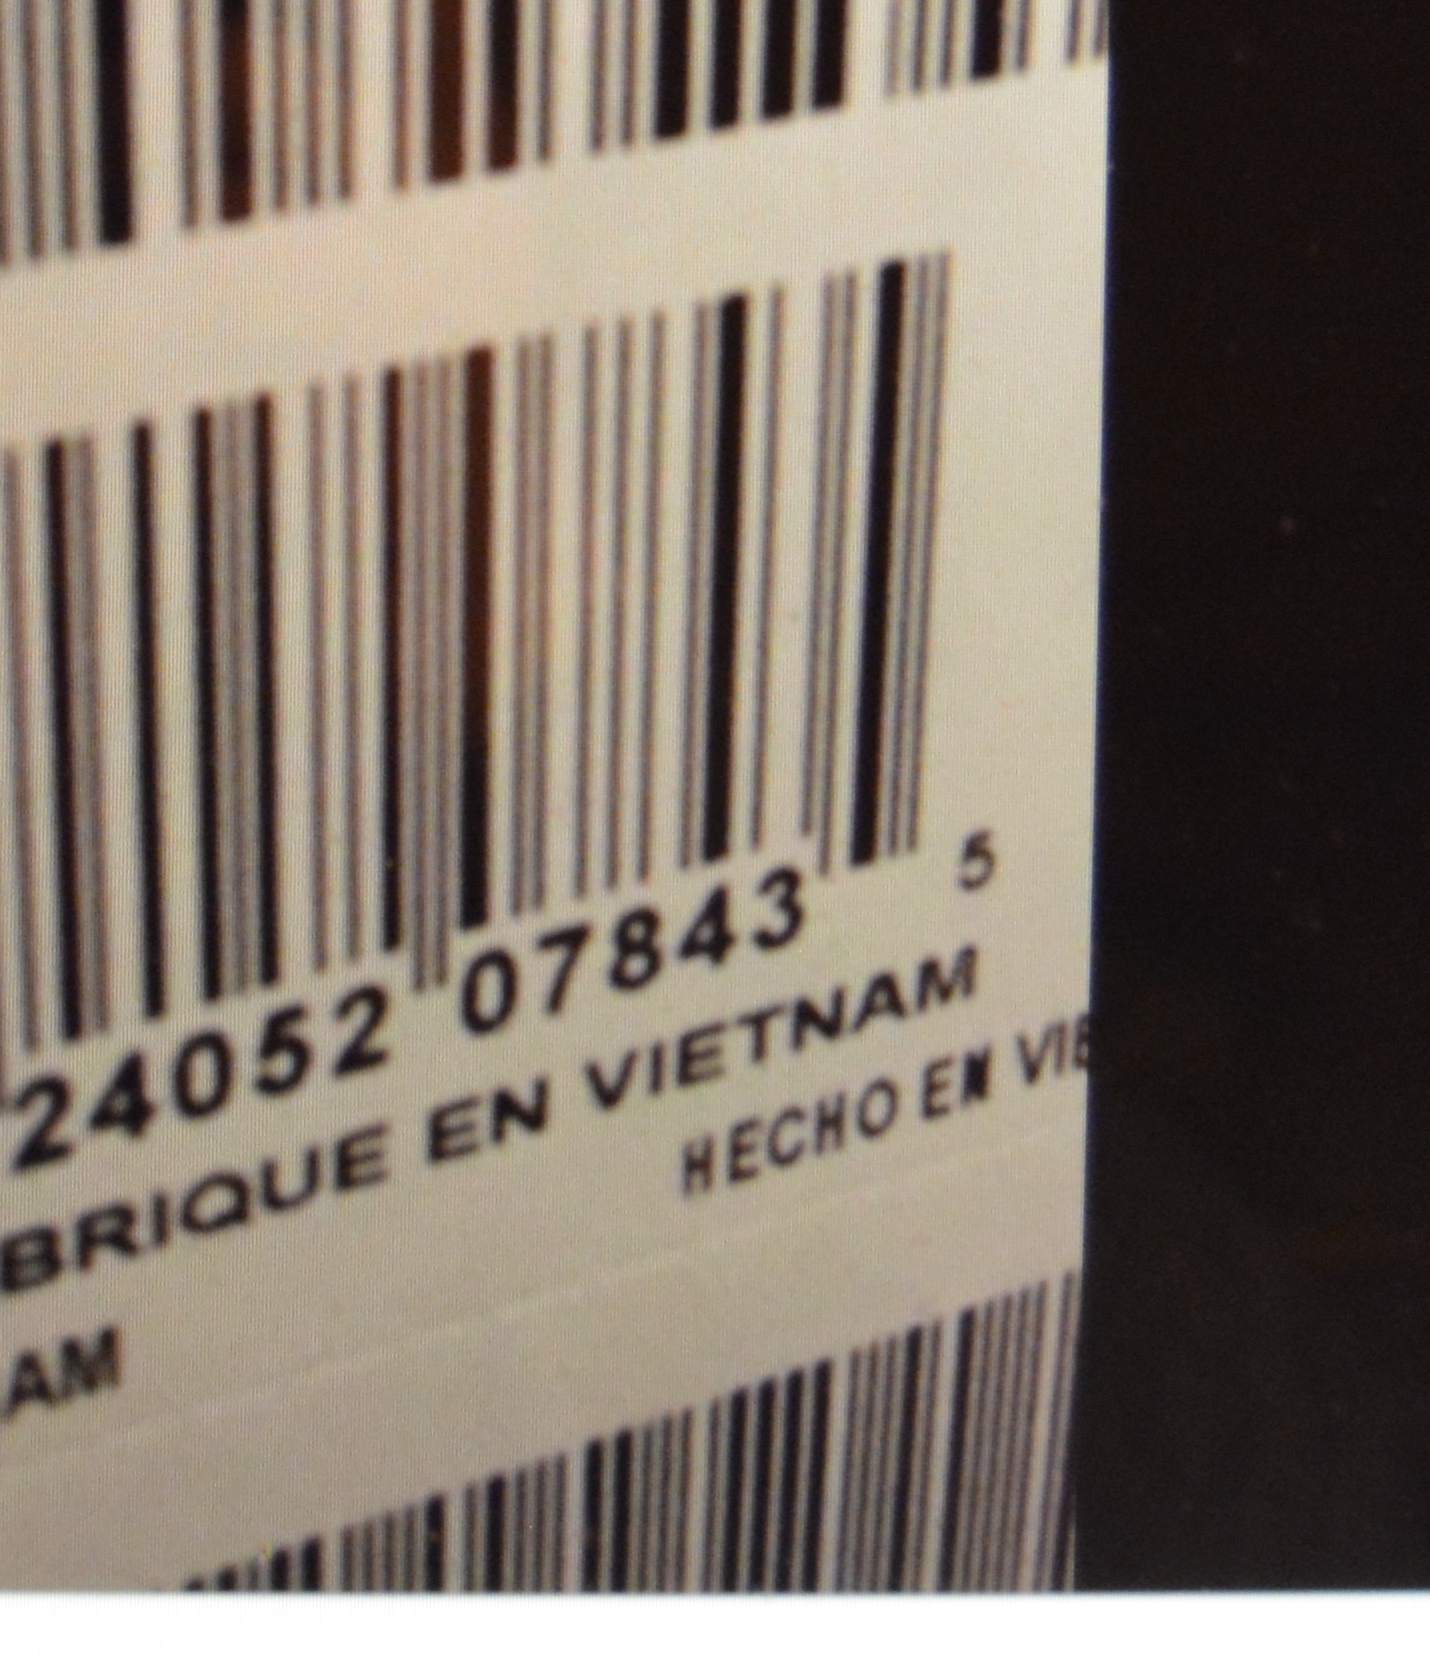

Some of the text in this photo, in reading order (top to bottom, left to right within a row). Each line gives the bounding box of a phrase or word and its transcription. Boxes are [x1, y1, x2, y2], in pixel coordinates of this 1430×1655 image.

[8, 986, 394, 1174] 24052
[457, 865, 806, 1036] 07843
[957, 828, 997, 892] 5
[425, 1074, 550, 1166] EN
[583, 944, 979, 1114] VIETNAM
[681, 1080, 897, 1198] HECHO
[920, 1041, 992, 1121] EN
